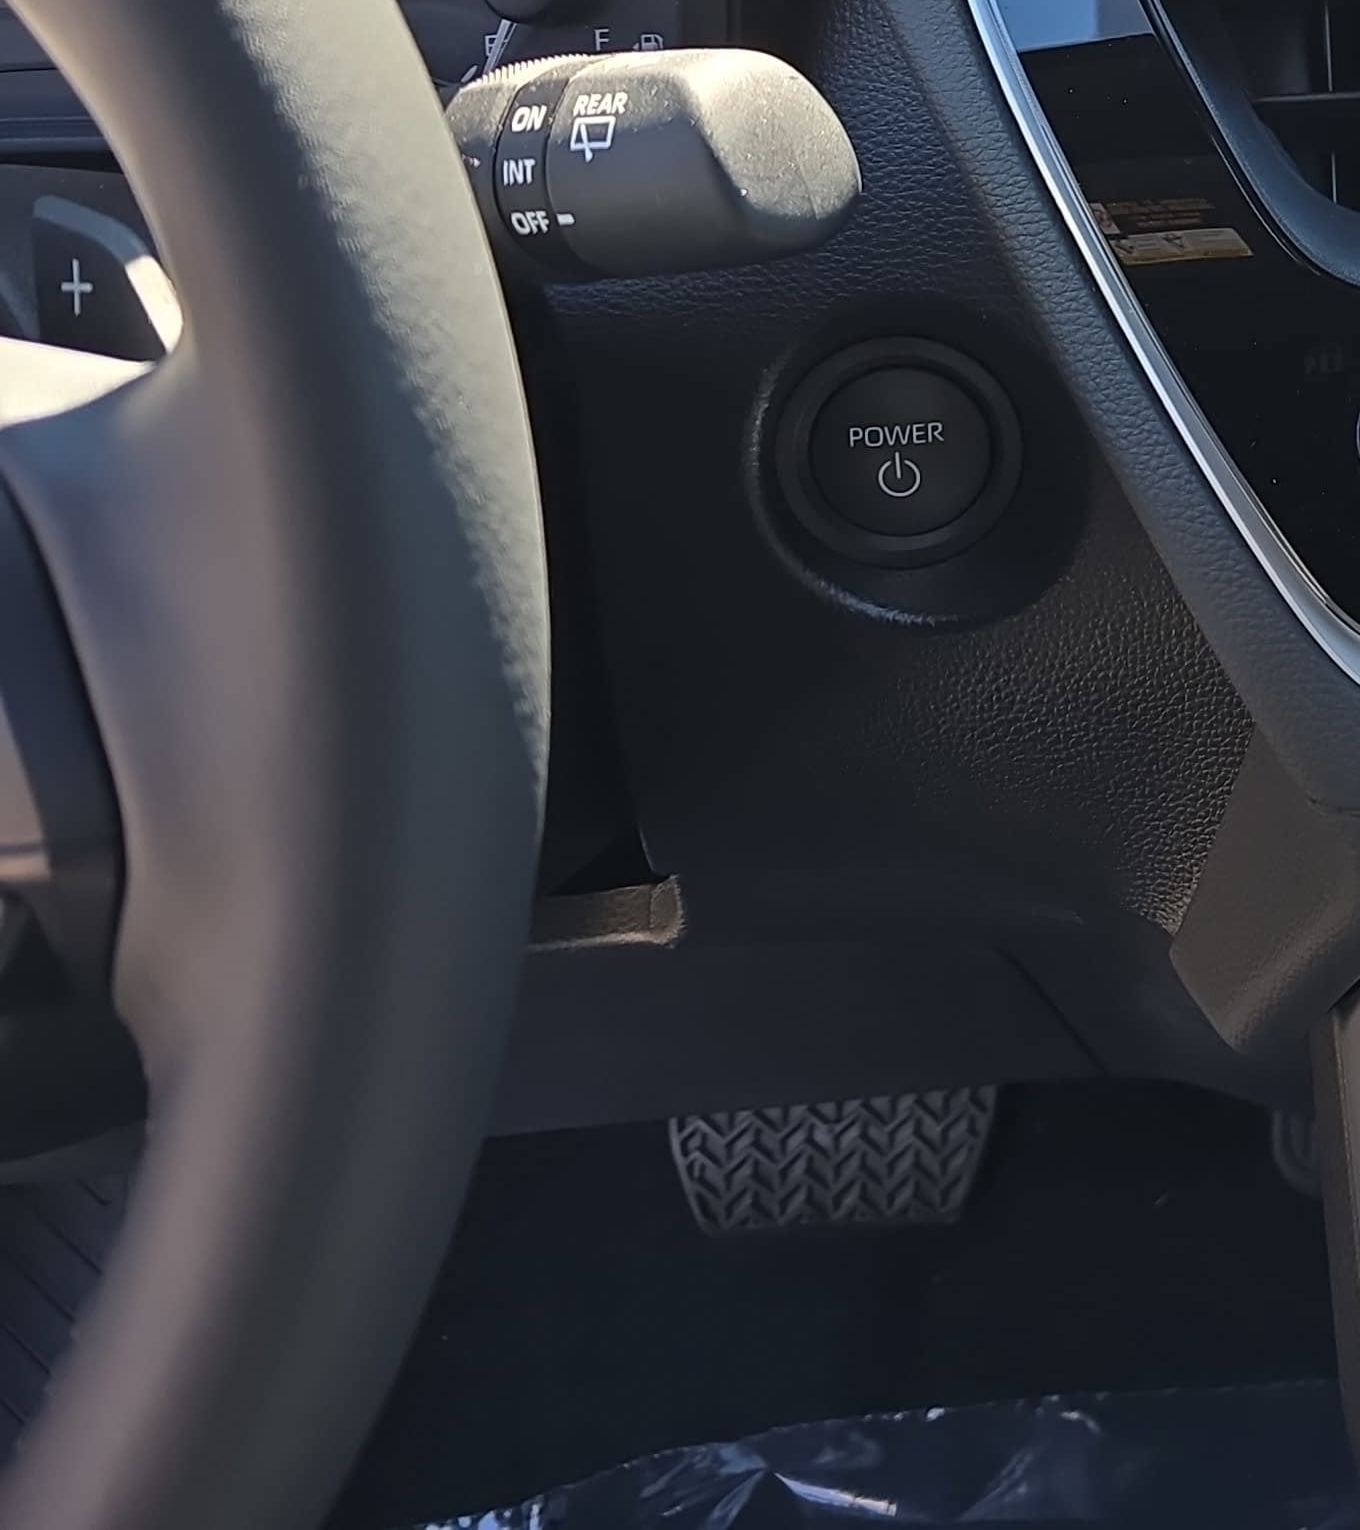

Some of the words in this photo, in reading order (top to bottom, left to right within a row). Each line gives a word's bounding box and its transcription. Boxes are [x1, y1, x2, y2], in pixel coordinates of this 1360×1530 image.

[594, 28, 610, 51] F
[572, 91, 629, 117] REAR
[511, 105, 547, 133] ON
[502, 159, 536, 187] INT
[510, 210, 551, 236] OFF
[847, 420, 945, 448] POWER
